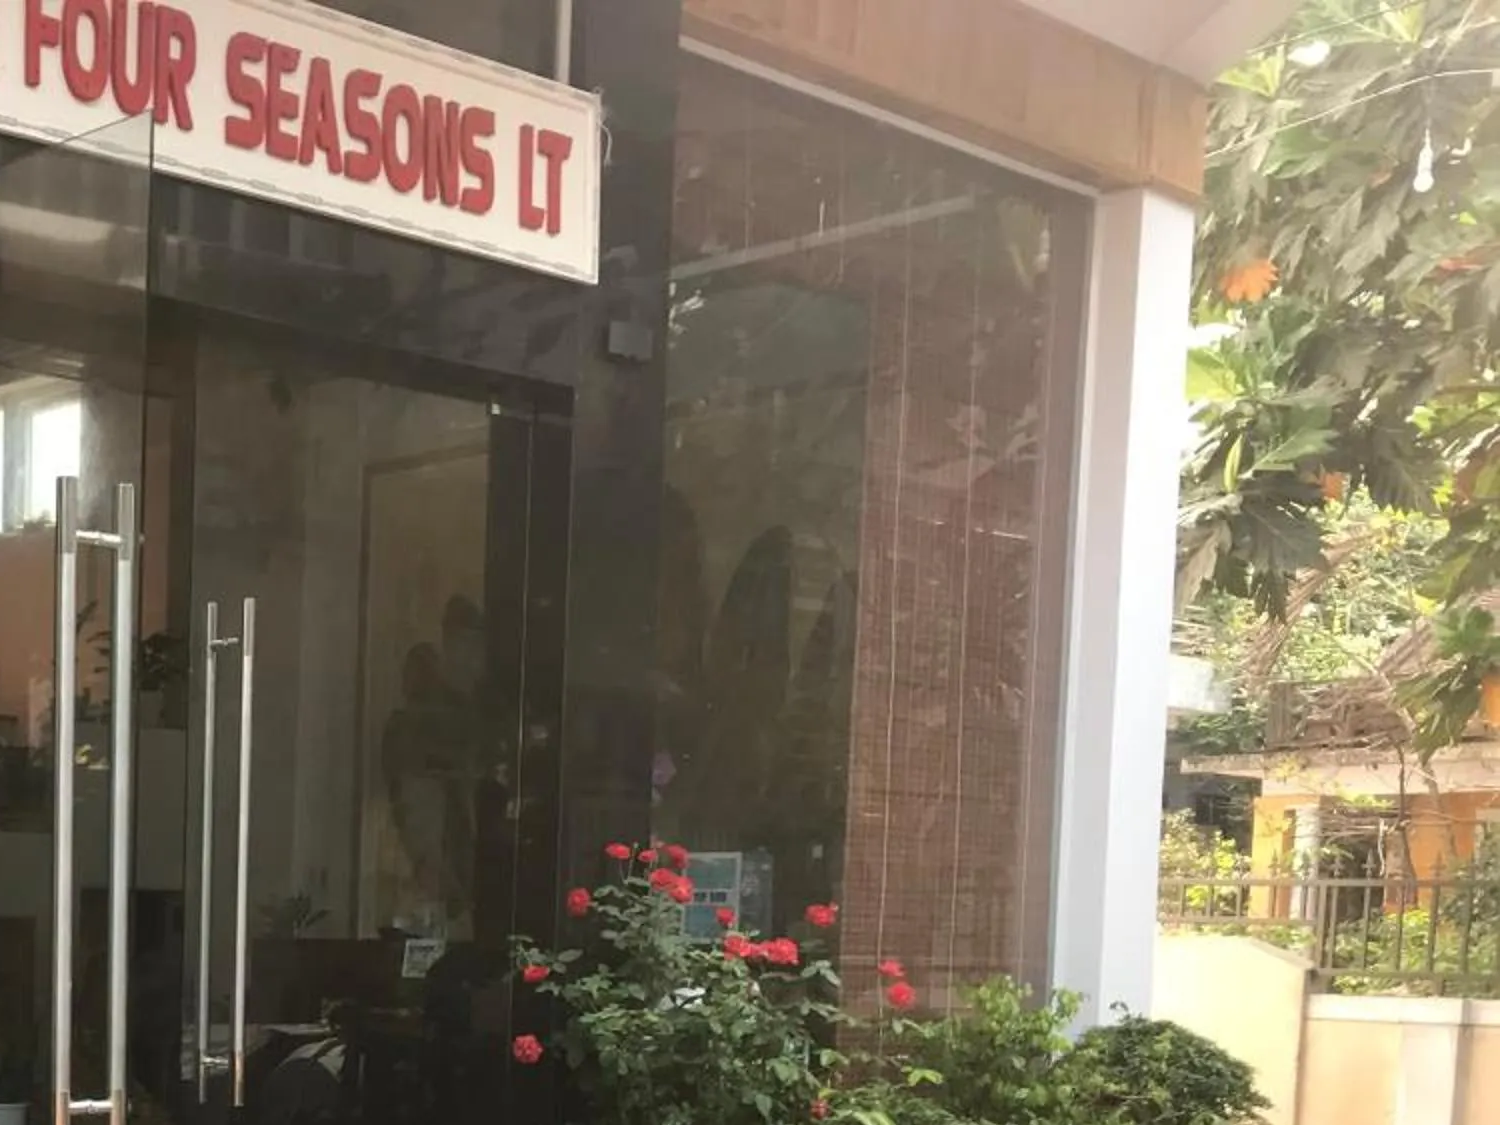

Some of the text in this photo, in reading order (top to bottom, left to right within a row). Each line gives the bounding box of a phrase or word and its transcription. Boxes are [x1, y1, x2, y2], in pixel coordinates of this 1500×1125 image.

[24, 0, 197, 131] FOUR
[224, 31, 496, 216] SEASONS
[518, 124, 573, 236] LT
